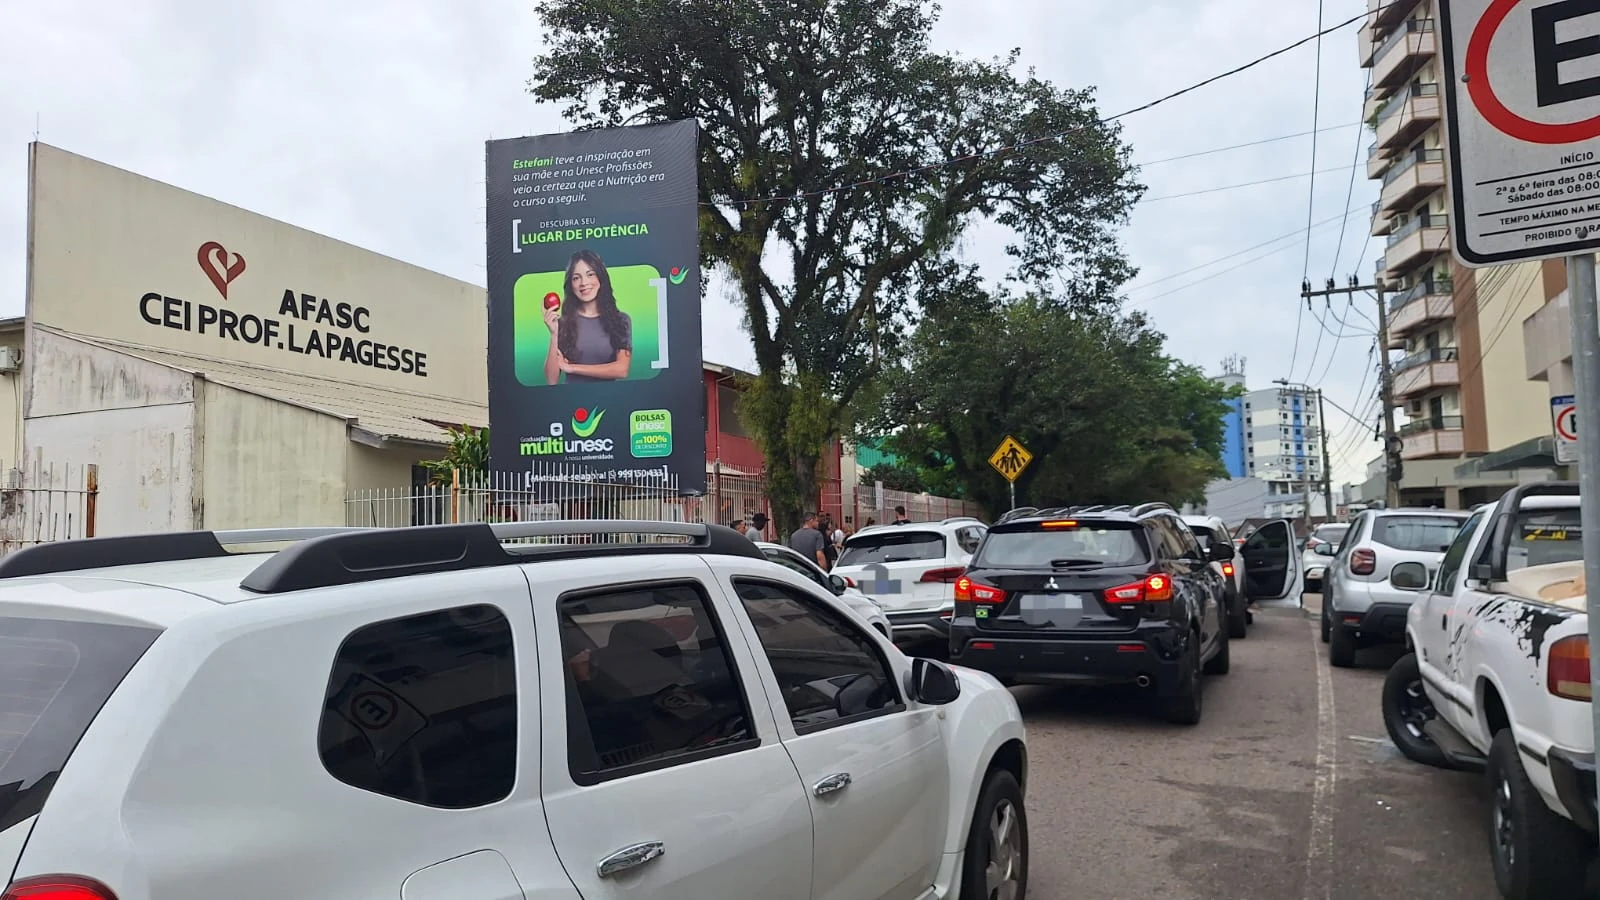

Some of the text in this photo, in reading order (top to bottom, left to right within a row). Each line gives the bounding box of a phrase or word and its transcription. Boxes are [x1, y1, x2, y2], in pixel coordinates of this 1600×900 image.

[513, 148, 651, 169] Estefani teve a inspiração em
[1560, 151, 1594, 165] INÍCIO
[513, 161, 653, 182] sua mãe e na Unesc Profissões
[513, 173, 665, 195] veio a certeza que a Nutrição era
[1533, 180, 1555, 190] feira
[1558, 176, 1575, 185] das
[513, 192, 587, 208] o curso a seguir.
[1508, 191, 1545, 204] Sábado
[1547, 188, 1564, 197] das
[540, 217, 596, 229] DESCUBRA SEU
[1500, 215, 1530, 226] TEMPO
[1532, 208, 1569, 220] MÁXIMO
[1571, 205, 1585, 214] NA
[521, 223, 649, 245] LUGAR DE POTÊNCIA
[1525, 228, 1572, 242] PROIBIDO
[139, 292, 191, 331] CEI
[279, 289, 370, 333] AFASC
[635, 414, 666, 422] BOLSAS
[643, 435, 667, 444] 100%
